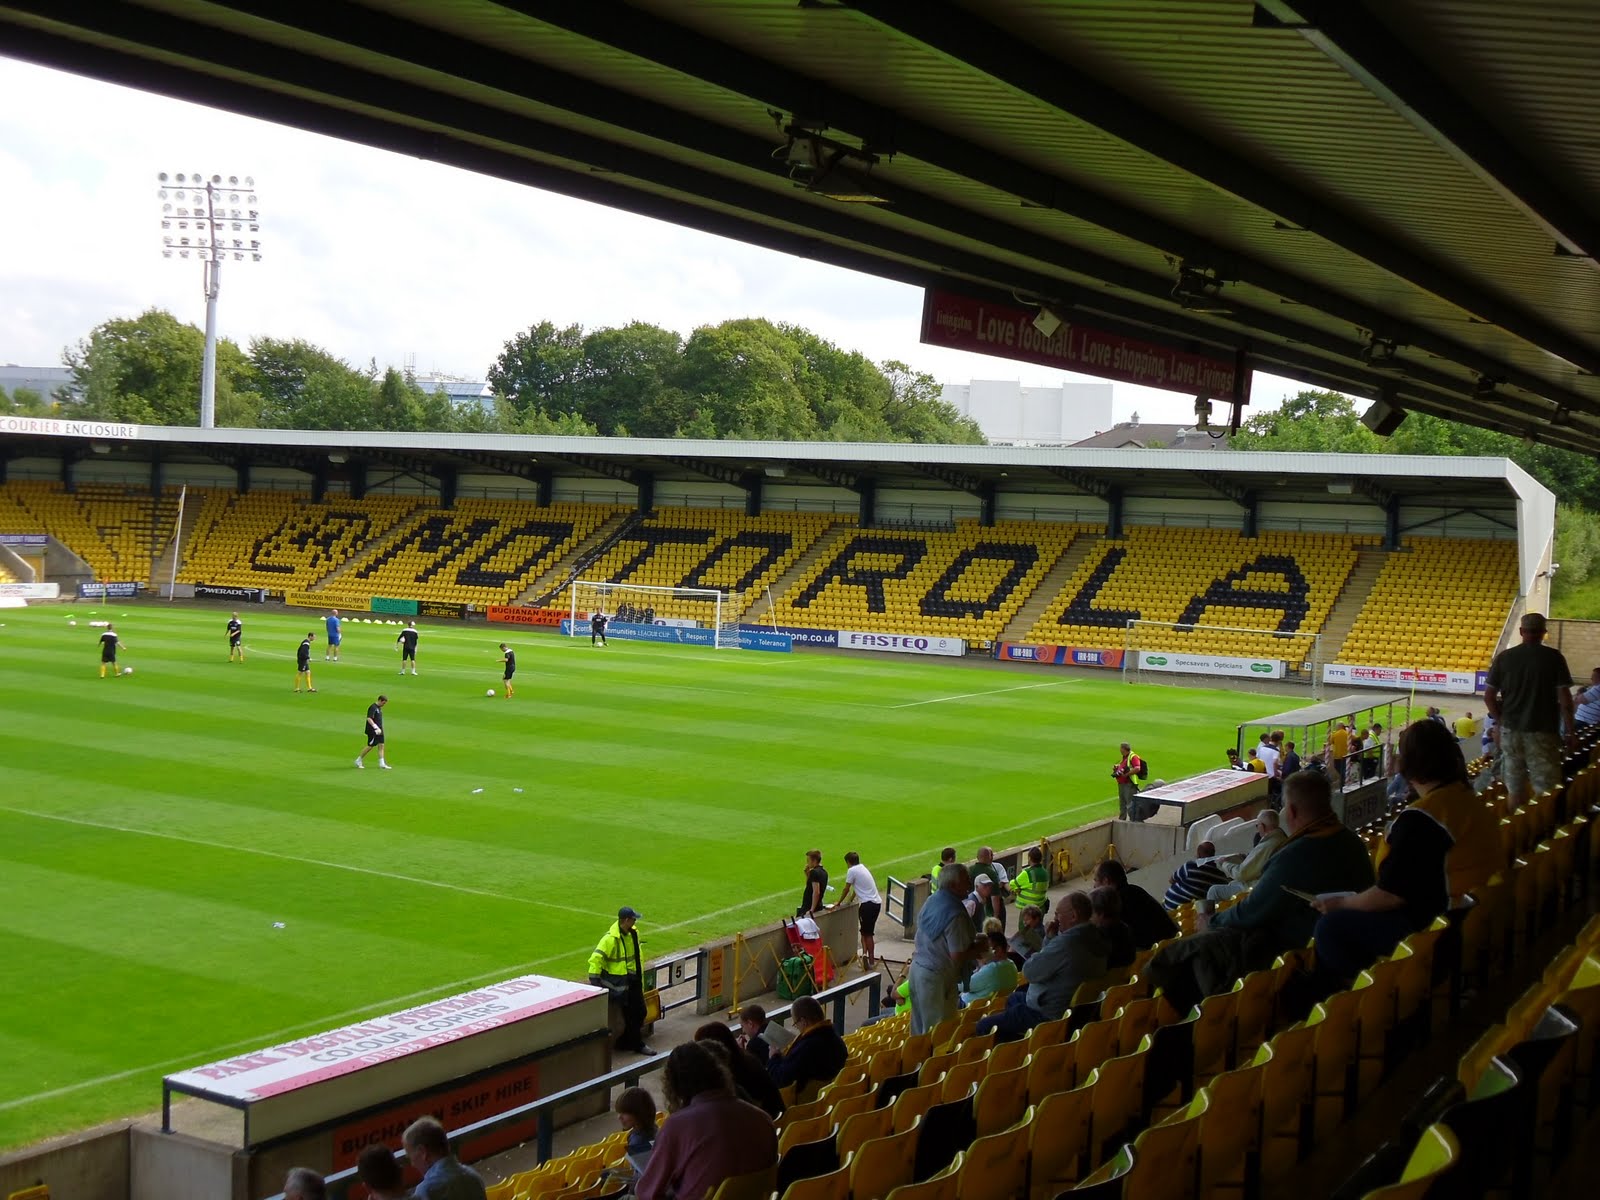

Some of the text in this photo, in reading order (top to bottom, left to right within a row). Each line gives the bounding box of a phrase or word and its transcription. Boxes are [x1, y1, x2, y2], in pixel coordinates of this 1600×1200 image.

[976, 307, 1016, 345] Love
[1080, 333, 1112, 368] Love
[1113, 342, 1167, 383] shopping.
[1169, 352, 1195, 384] Love
[0, 419, 134, 438] COURIER ENCLOSURE
[195, 587, 245, 596] POWERADE
[291, 593, 370, 604] BRAIDWOOD MOTOR COMPANY
[492, 607, 585, 620] BUCHANAN SKIP HRE
[685, 632, 708, 641] Respect
[758, 638, 786, 648] Tolerance
[850, 633, 929, 651] FASTEQ
[1175, 659, 1243, 670] Specsavers Opticians
[675, 965, 682, 979] 5
[193, 979, 541, 1080] PARK DIGITAL SYSTEMS LTD
[310, 1003, 511, 1062] COLOUR COPIERS
[341, 1075, 532, 1155] BUCHAN SKIP HIRE
